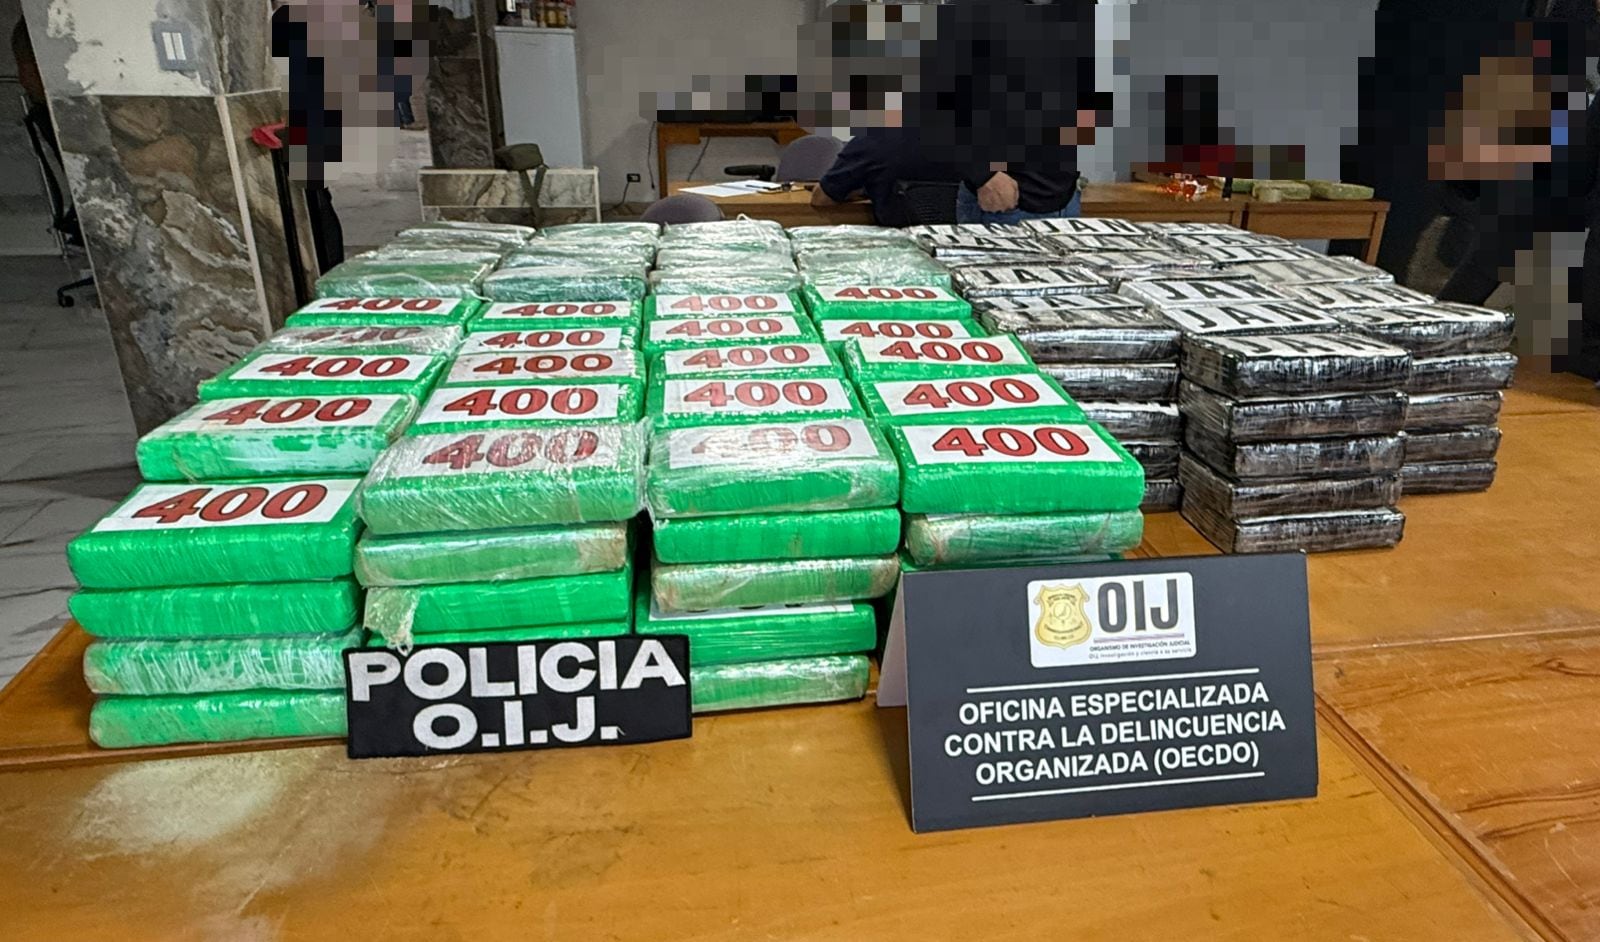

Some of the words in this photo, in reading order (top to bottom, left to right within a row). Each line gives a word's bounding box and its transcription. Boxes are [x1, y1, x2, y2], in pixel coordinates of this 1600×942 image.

[1041, 219, 1136, 232] JAN
[946, 234, 1041, 249] JAN
[980, 269, 1094, 285] JAN
[835, 287, 939, 299] 400
[1153, 281, 1286, 300] JAN
[1306, 286, 1428, 304] JAN
[320, 298, 443, 311] 400
[501, 303, 617, 316] 400
[669, 295, 779, 311] 400
[666, 318, 783, 337] 400
[1182, 303, 1325, 329] JAN
[483, 330, 605, 348] 400
[838, 321, 953, 339] 400
[880, 340, 1004, 363] 400
[1229, 333, 1391, 354] JAN
[258, 356, 410, 377] 400
[473, 353, 613, 375] 400
[682, 345, 810, 368] 400
[443, 388, 599, 416] 400
[683, 381, 828, 407] 400
[903, 378, 1040, 409] 400
[203, 398, 372, 425] 400
[422, 430, 599, 469] 400
[931, 426, 1091, 457] 400
[131, 484, 328, 524] 400
[1098, 579, 1179, 633] OIJ
[348, 639, 686, 701] POLICIA
[959, 701, 1065, 725] OFICINA
[1071, 681, 1269, 718] ESPECIALIZADA
[413, 696, 619, 749] O.I.J.
[944, 728, 1055, 757] CONTRA
[1061, 724, 1095, 748] LA
[1100, 709, 1286, 745] DELINCUENCIA
[975, 750, 1148, 785] ORGANIZADA
[1153, 740, 1260, 776] (OECDO)
